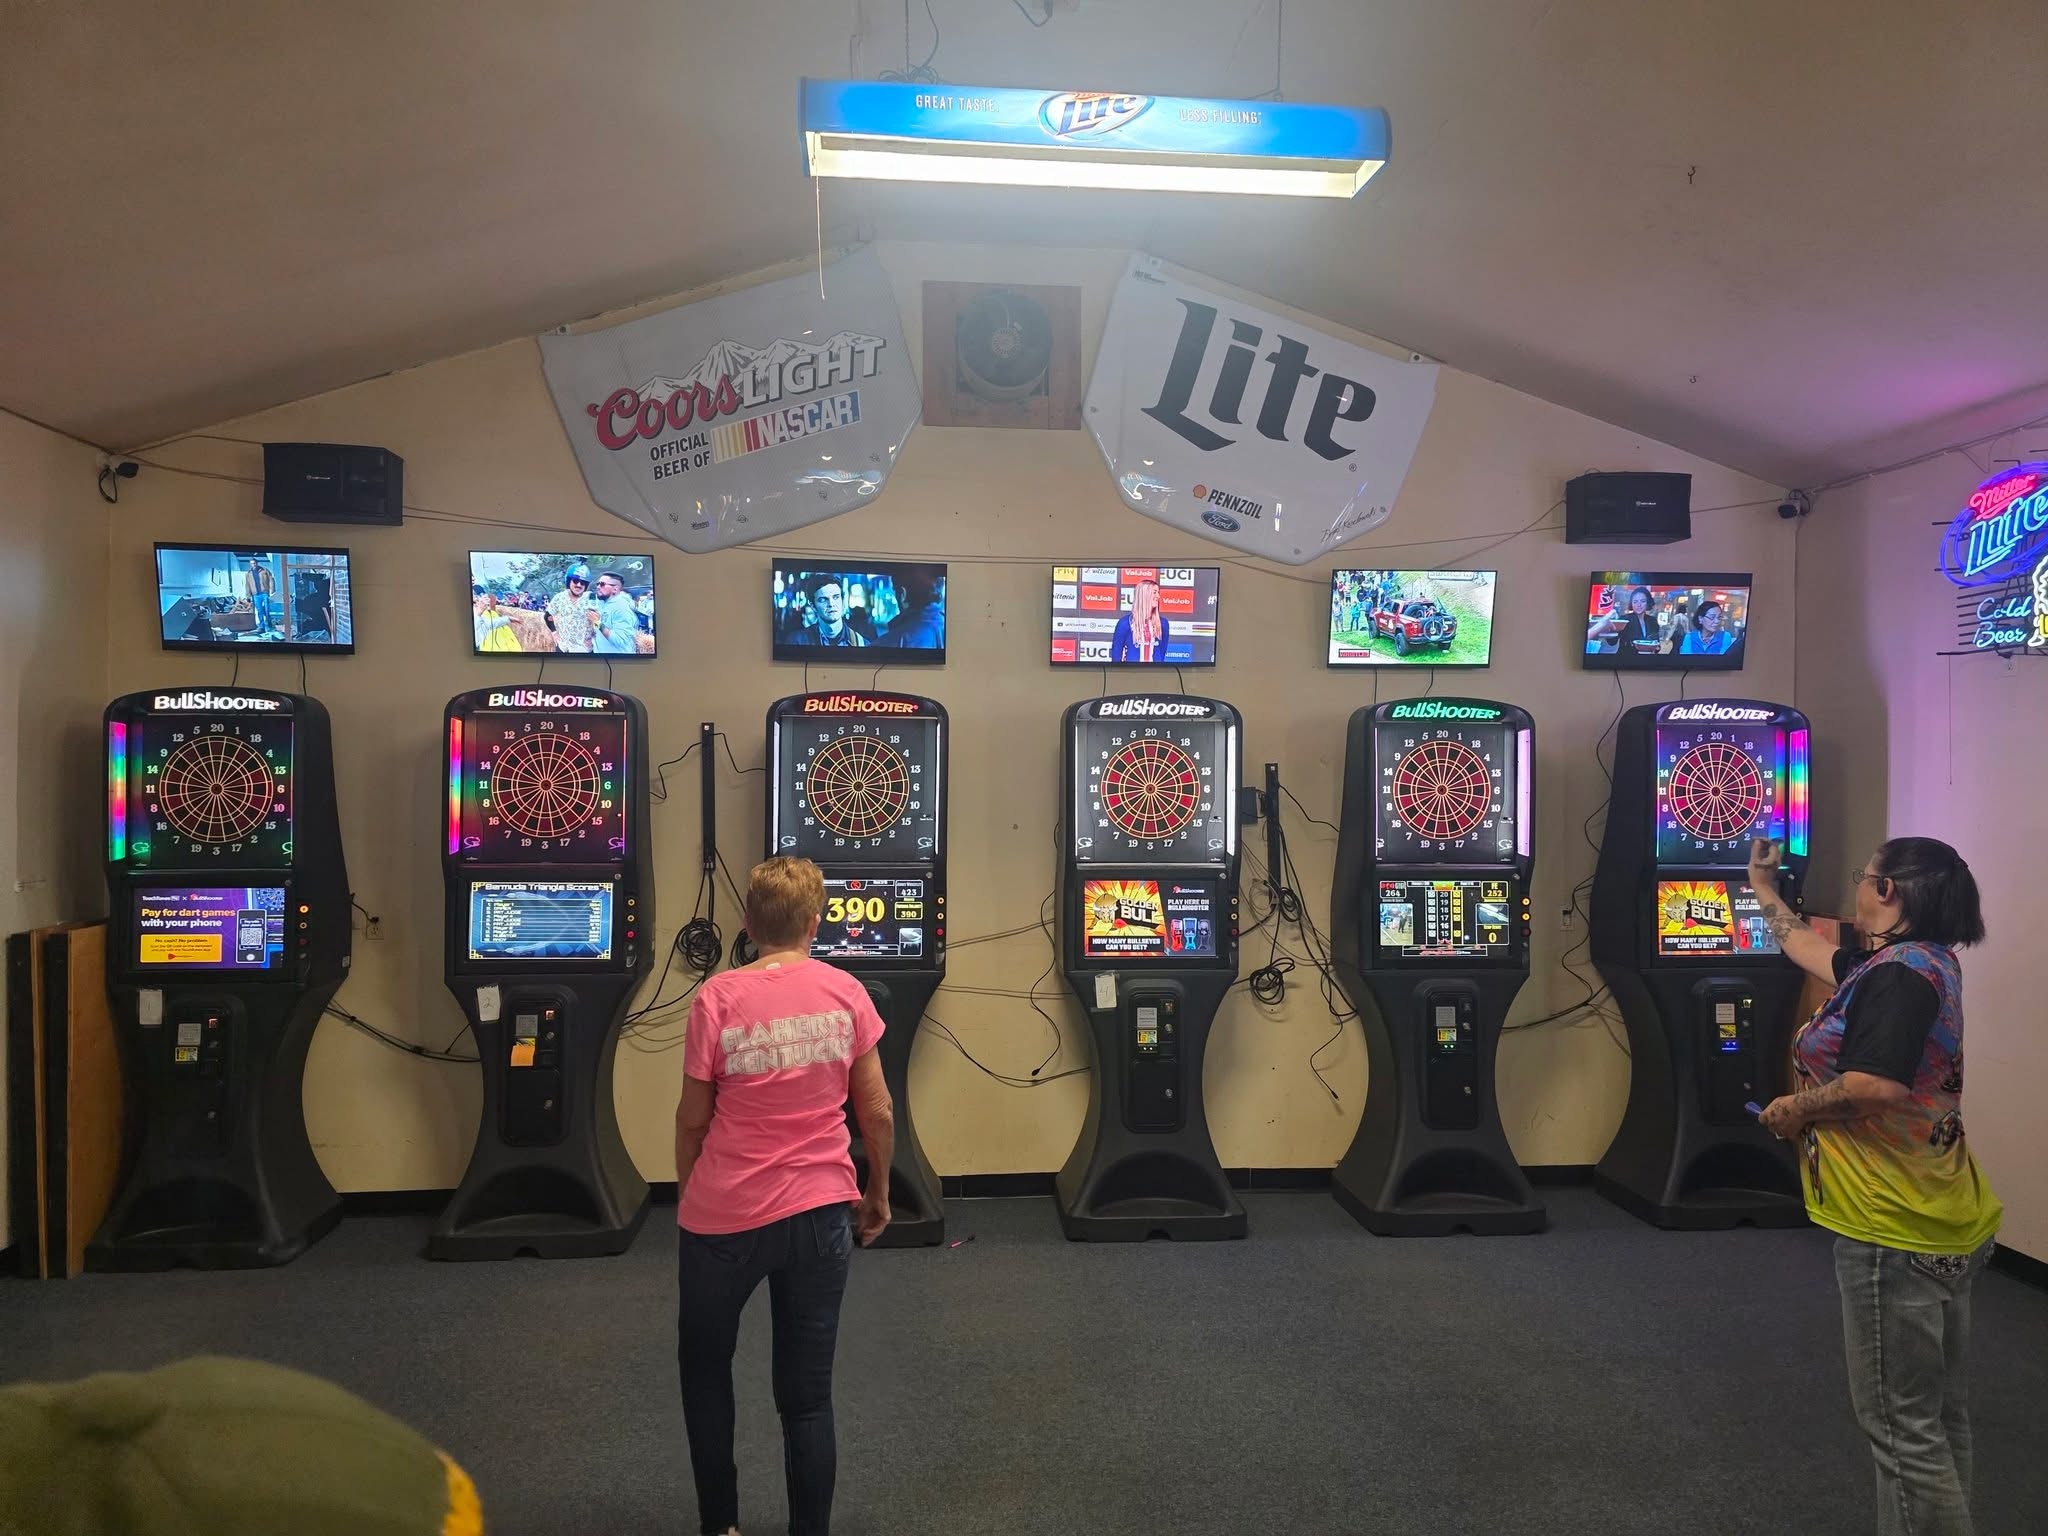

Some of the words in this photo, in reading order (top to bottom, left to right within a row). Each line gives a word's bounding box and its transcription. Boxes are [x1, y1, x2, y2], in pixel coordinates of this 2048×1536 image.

[916, 94, 953, 110] GREAT
[1180, 108, 1208, 121] LESS
[1140, 298, 1376, 461] Lite
[587, 373, 740, 450] Coors
[743, 339, 886, 407] LIGHT
[758, 394, 853, 446] NASCAR
[651, 432, 709, 461] OFFICIAL
[653, 458, 690, 481] BEER
[694, 450, 711, 468] OF
[1970, 475, 2036, 515] Miller
[1208, 488, 1262, 519] PENNZOIL
[1166, 570, 1192, 581] UCI
[1977, 596, 2033, 620] Cold
[1972, 621, 2027, 648] Beer
[193, 726, 200, 734] 5
[210, 724, 224, 732] 20
[838, 727, 845, 735] 5
[853, 725, 865, 733] 20
[172, 734, 184, 742] 12
[819, 734, 829, 742] 12
[1422, 732, 1429, 740] 5
[1437, 730, 1448, 738] 20
[250, 734, 262, 743] 18
[890, 735, 900, 743] 18
[1472, 740, 1481, 748] 18
[160, 749, 168, 757] 9
[266, 749, 273, 757] 4
[808, 748, 815, 756] 9
[1395, 753, 1400, 761] 9
[147, 765, 158, 773] 14
[274, 766, 286, 775] 13
[796, 763, 807, 771] 14
[911, 765, 921, 773] 13
[1491, 769, 1501, 777] 13
[146, 785, 155, 793] 11
[277, 785, 285, 793] 6
[795, 782, 803, 790] 11
[150, 804, 158, 812] 8
[273, 804, 285, 812] 10
[799, 800, 805, 808] 8
[910, 801, 920, 809] 10
[1386, 803, 1393, 811] 8
[804, 817, 814, 825] 16
[1483, 820, 1492, 828] 15
[156, 822, 167, 830] 16
[819, 830, 826, 838] 7
[889, 830, 895, 838] 2
[173, 836, 180, 844] 7
[251, 836, 258, 844] 2
[834, 838, 845, 846] 19
[871, 838, 881, 846] 17
[1420, 840, 1430, 848] 19
[1455, 840, 1464, 848] 17
[191, 844, 202, 853] 19
[213, 847, 220, 855] 3
[231, 844, 242, 852] 17
[528, 883, 565, 892] Triangle
[901, 888, 917, 896] 423
[1120, 898, 1159, 911] GOLDEN
[1690, 898, 1727, 911] GOLDEN
[141, 908, 161, 918] Pay
[162, 908, 177, 916] for
[178, 908, 200, 917] dart
[202, 909, 236, 918] games
[826, 897, 885, 922] 390
[901, 910, 917, 918] 390
[1120, 905, 1157, 923] BULL
[1690, 905, 1725, 923] BULL
[165, 920, 188, 928] your
[190, 919, 223, 928] phone
[1488, 932, 1497, 943] 0
